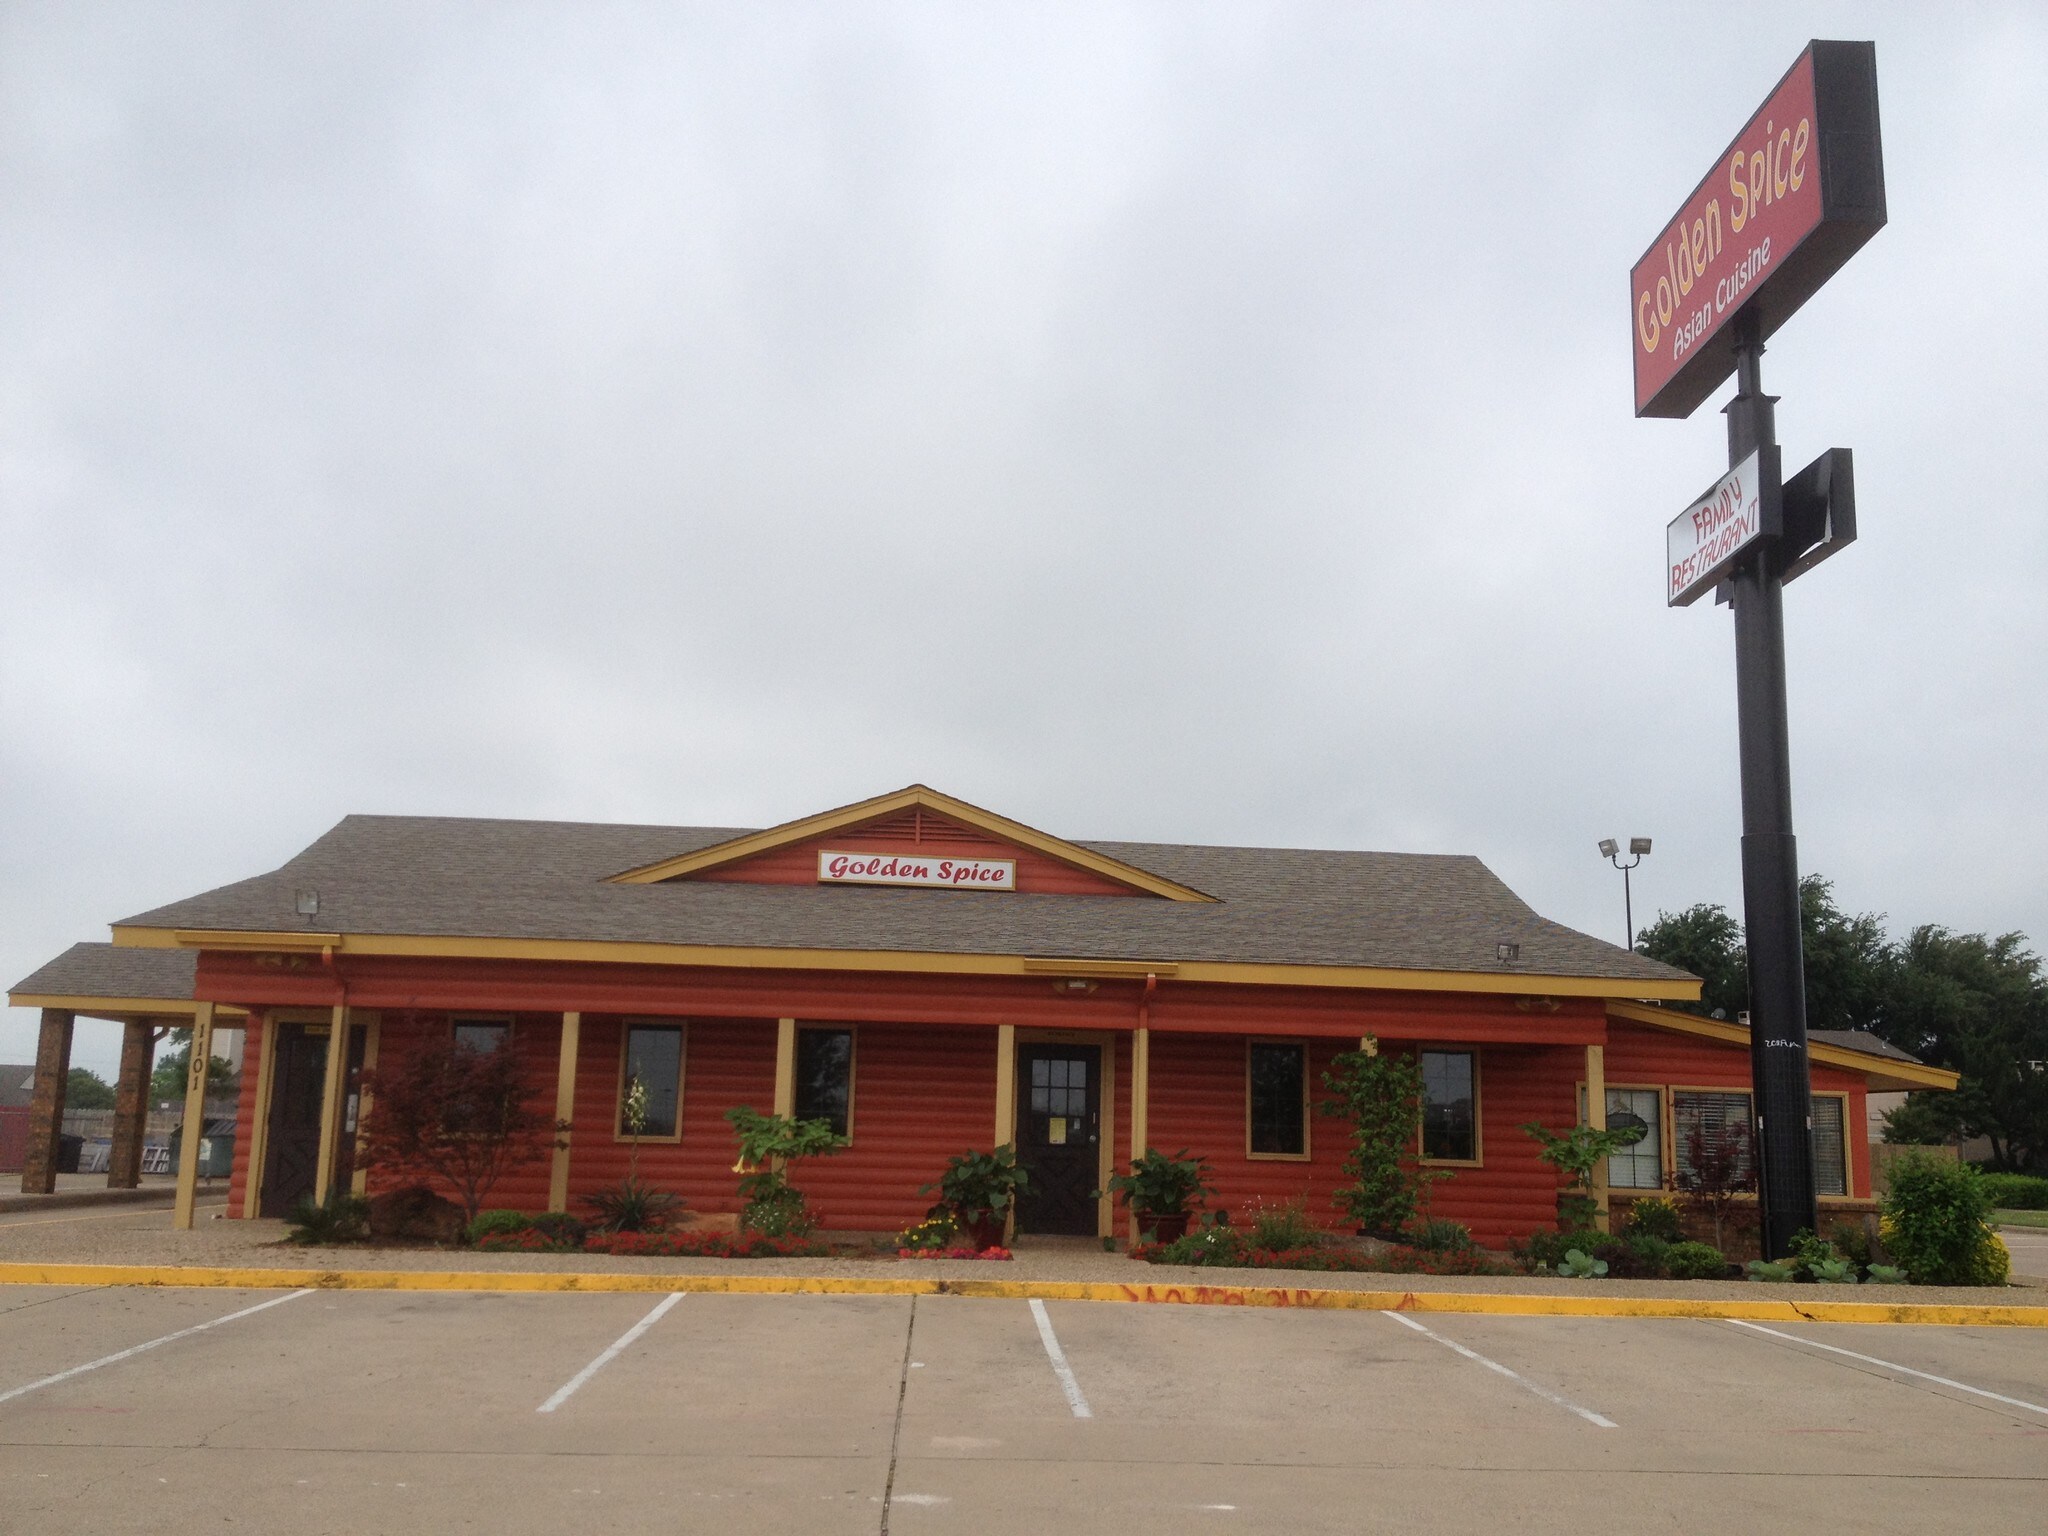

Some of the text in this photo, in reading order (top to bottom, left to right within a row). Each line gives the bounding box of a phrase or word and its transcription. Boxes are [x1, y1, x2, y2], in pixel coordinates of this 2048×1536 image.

[1638, 117, 1810, 353] Golden Spice
[1673, 236, 1772, 360] Asian Cuisine
[1671, 497, 1758, 595] RESTAURANT
[1692, 476, 1743, 544] FAMILY
[829, 856, 1005, 884] Golden Spice
[193, 1023, 205, 1090] 1101
